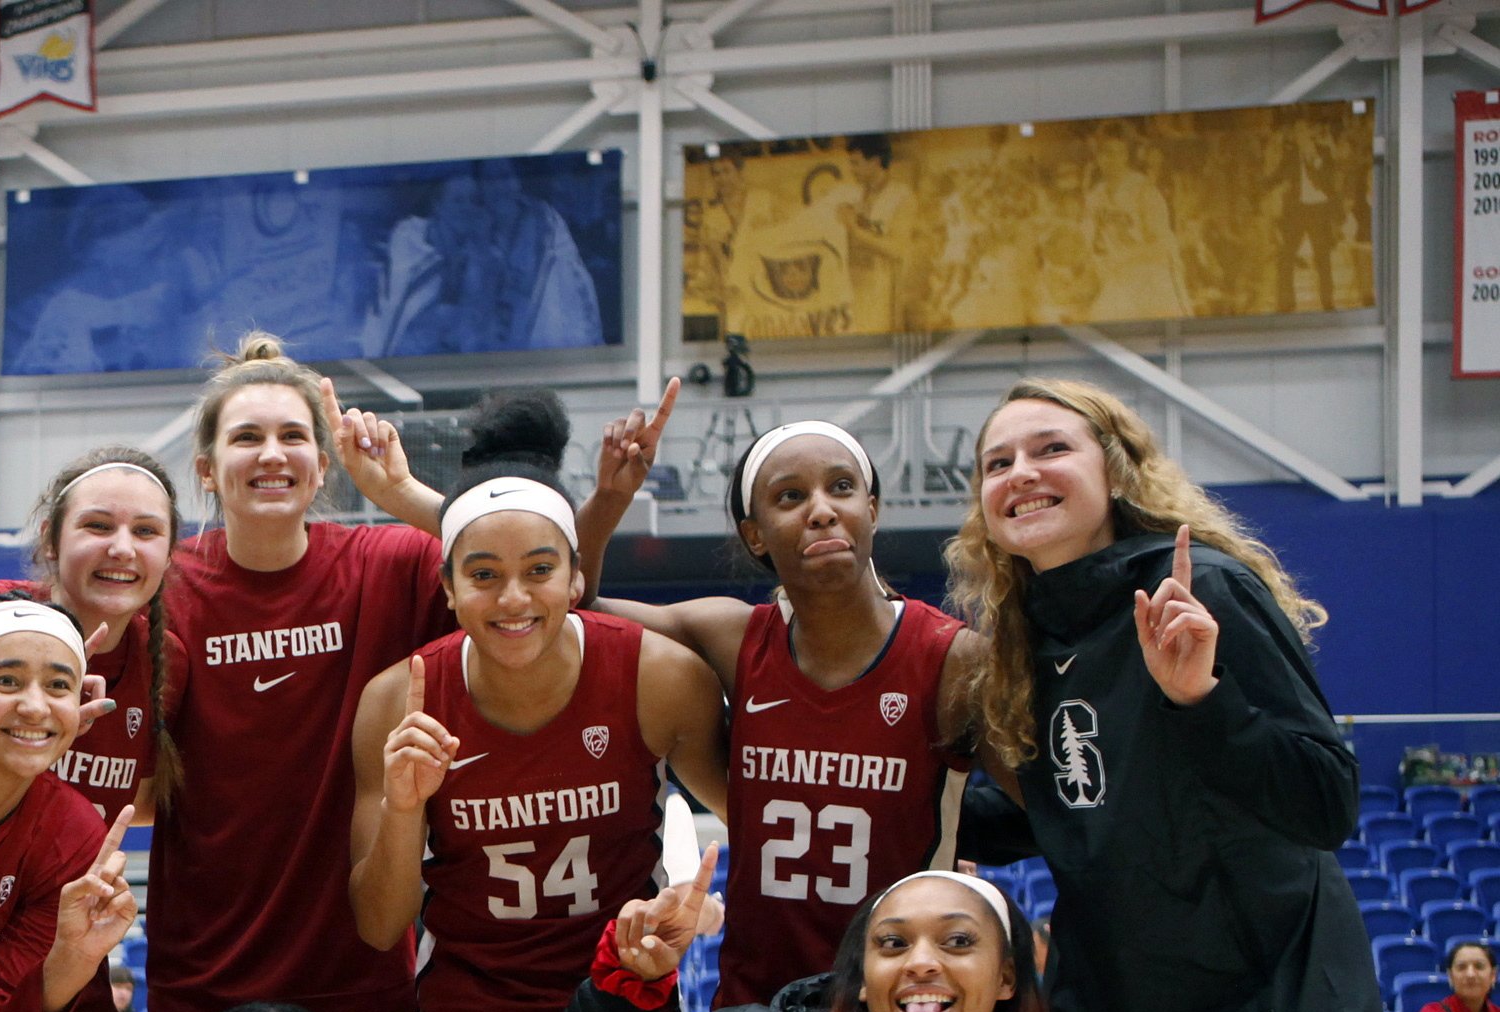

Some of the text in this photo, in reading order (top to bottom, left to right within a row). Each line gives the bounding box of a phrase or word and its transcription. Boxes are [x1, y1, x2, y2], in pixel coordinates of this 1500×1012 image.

[1473, 130, 1500, 143] RO
[1474, 148, 1500, 166] 199
[1473, 173, 1500, 191] 200
[205, 621, 344, 667] STANFORD
[49, 750, 137, 789] NFORD
[742, 745, 907, 792] STANFORD
[451, 781, 621, 832] STANFORD
[761, 799, 871, 905] 23
[482, 835, 600, 920] 54
